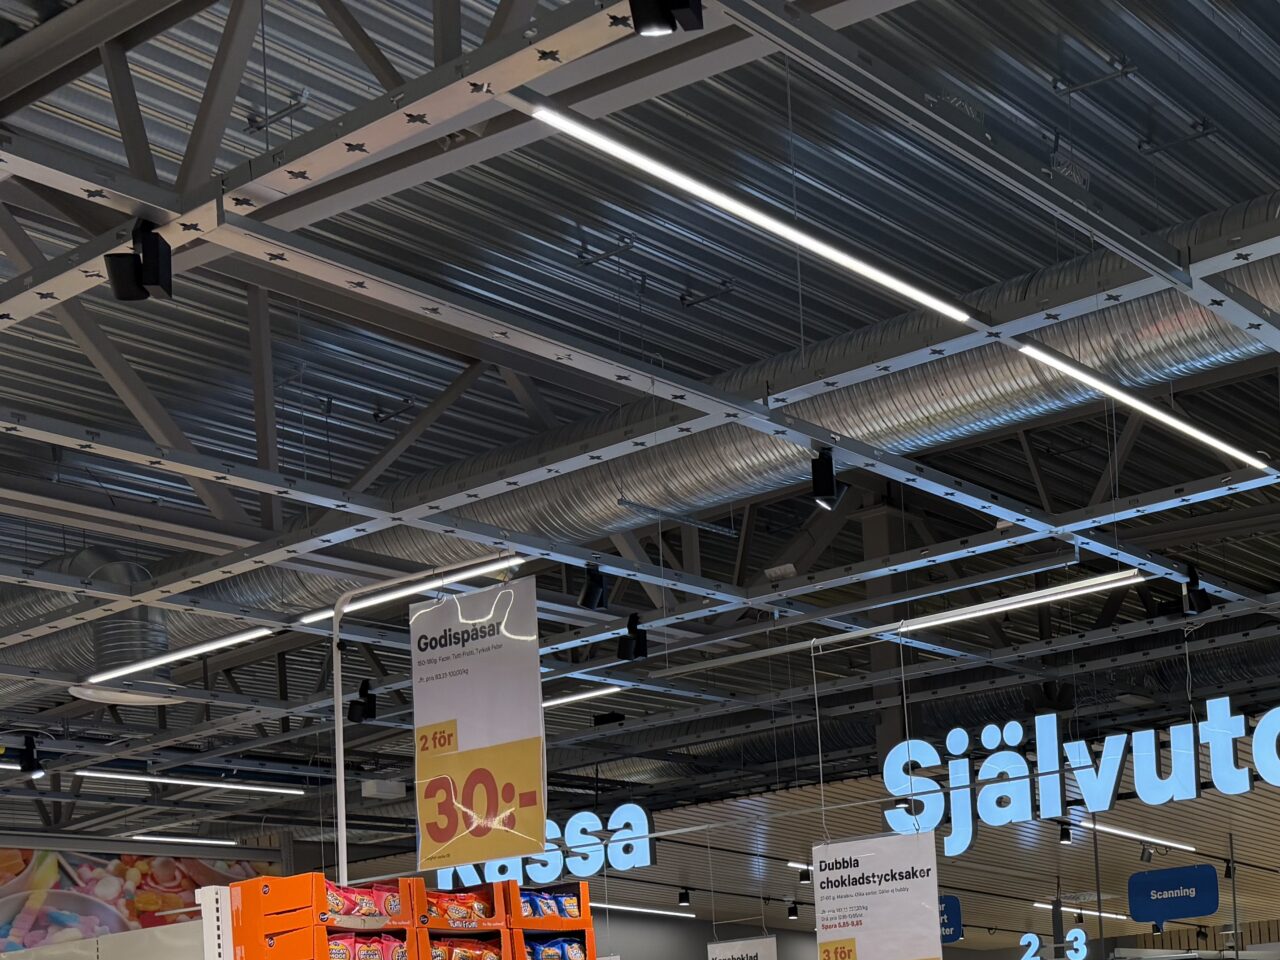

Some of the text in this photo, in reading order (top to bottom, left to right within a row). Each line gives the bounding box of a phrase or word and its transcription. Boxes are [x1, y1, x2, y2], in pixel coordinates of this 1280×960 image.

[417, 621, 503, 652] Godispåsar
[420, 730, 453, 752] 2 för
[424, 768, 537, 843] 30:-
[819, 856, 859, 872] Dubbla
[820, 866, 931, 890] chokladstycksaker
[1150, 886, 1196, 900] Scanning
[821, 922, 837, 931] Spara
[834, 947, 853, 960] för
